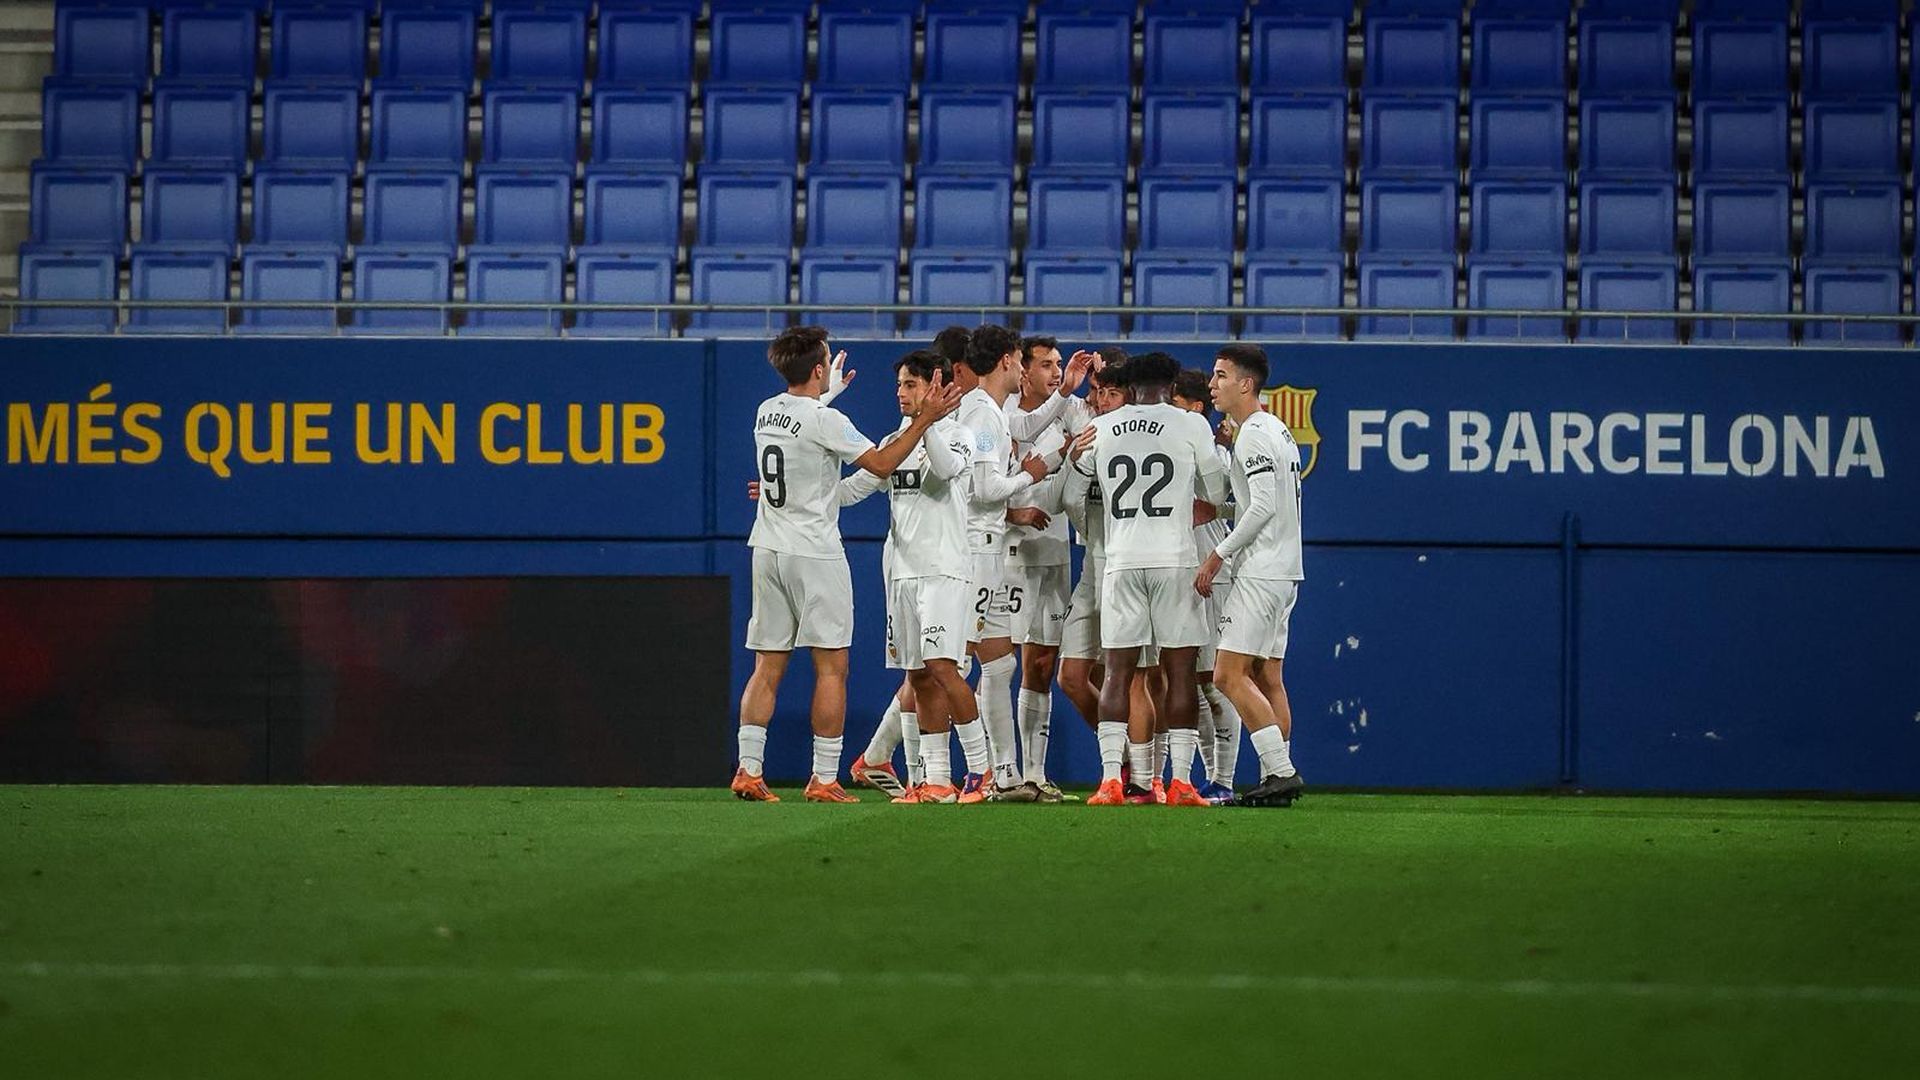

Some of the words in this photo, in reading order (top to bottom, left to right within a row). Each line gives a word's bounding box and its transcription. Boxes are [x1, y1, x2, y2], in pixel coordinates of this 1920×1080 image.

[8, 383, 162, 464] MÉS
[185, 402, 332, 478] QUE
[355, 402, 456, 464] UN
[480, 402, 666, 465] CLUB
[758, 412, 792, 431] MARIO
[790, 421, 802, 438] D.
[1112, 419, 1165, 437] OTORBI
[1348, 410, 1430, 472] FC
[1449, 410, 1884, 478] BARCELONA
[761, 444, 787, 509] 9
[1107, 452, 1175, 520] 22
